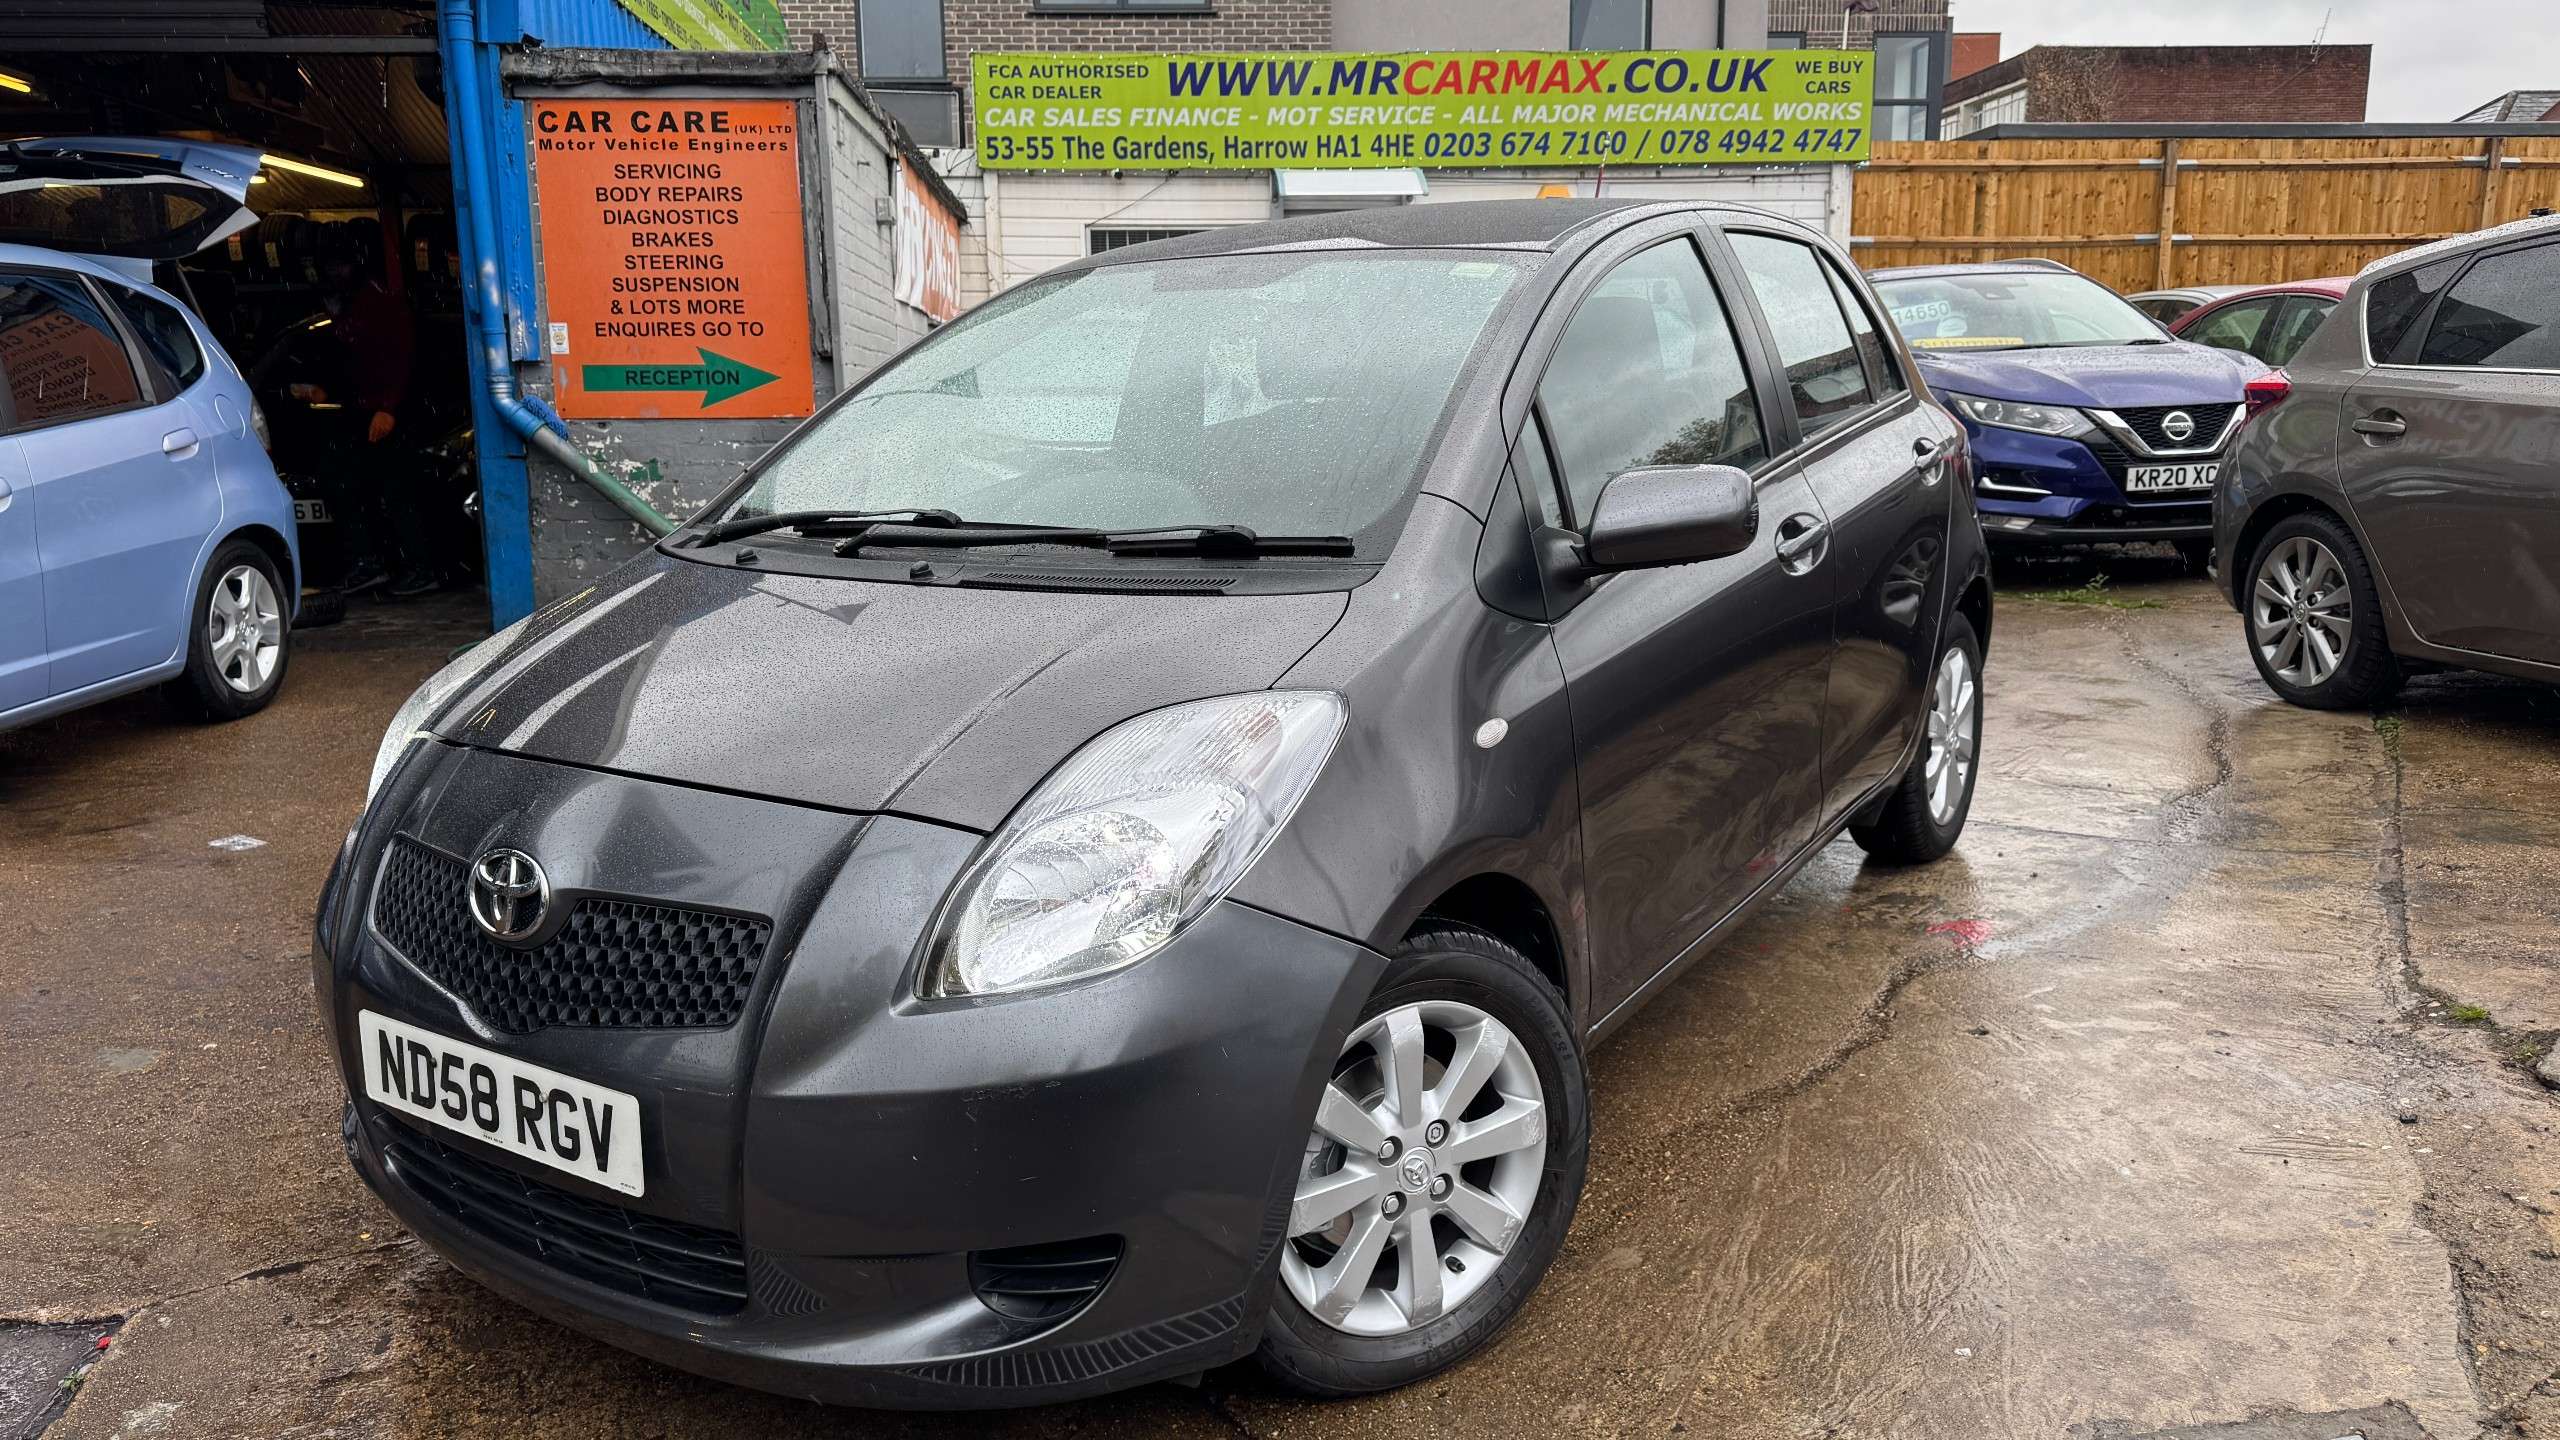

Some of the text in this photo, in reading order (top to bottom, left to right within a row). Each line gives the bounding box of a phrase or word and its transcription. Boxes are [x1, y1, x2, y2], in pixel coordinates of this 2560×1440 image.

[989, 64, 1149, 78] FCA AUTHORISED
[1795, 60, 1864, 74] WE BUY
[1167, 57, 1775, 96] WWW.MRCARMAX.CO.UK
[989, 85, 1102, 99] CAR DEALER
[1805, 80, 1851, 94] CARS
[984, 107, 1035, 127] CAR
[1043, 107, 1122, 127] SALES
[1129, 106, 1242, 127] FINANCE
[1267, 106, 1322, 126] MOT
[1328, 105, 1436, 126] SERVICE
[1459, 104, 1504, 125] ALL
[1511, 103, 1595, 124] MAJOR
[1604, 102, 1763, 123] MECHANICAL
[1774, 101, 1862, 121] WORKS
[537, 110, 792, 135] CAR CARE (UK) LTD
[538, 138, 789, 154] Motor Vehicle Engineers
[986, 128, 1862, 164] 53-55 The Gardens, Harrow HA1 4HE 0203 674 7100 / 078 4942 4747
[614, 163, 721, 180] SERVICING
[595, 186, 743, 202] BODY REPAIRS
[603, 209, 739, 225] DIAGNOSTICS
[632, 232, 714, 247] BRAKES
[624, 254, 724, 270] STEERING
[612, 277, 739, 292] SUSPENSION
[610, 299, 745, 315] & LOTS MORE
[595, 321, 764, 338] ENQUIRES GO TO
[625, 369, 740, 386] RECEPTION
[2135, 467, 2188, 488] KR20
[378, 1028, 614, 1173] ND58 RGV
